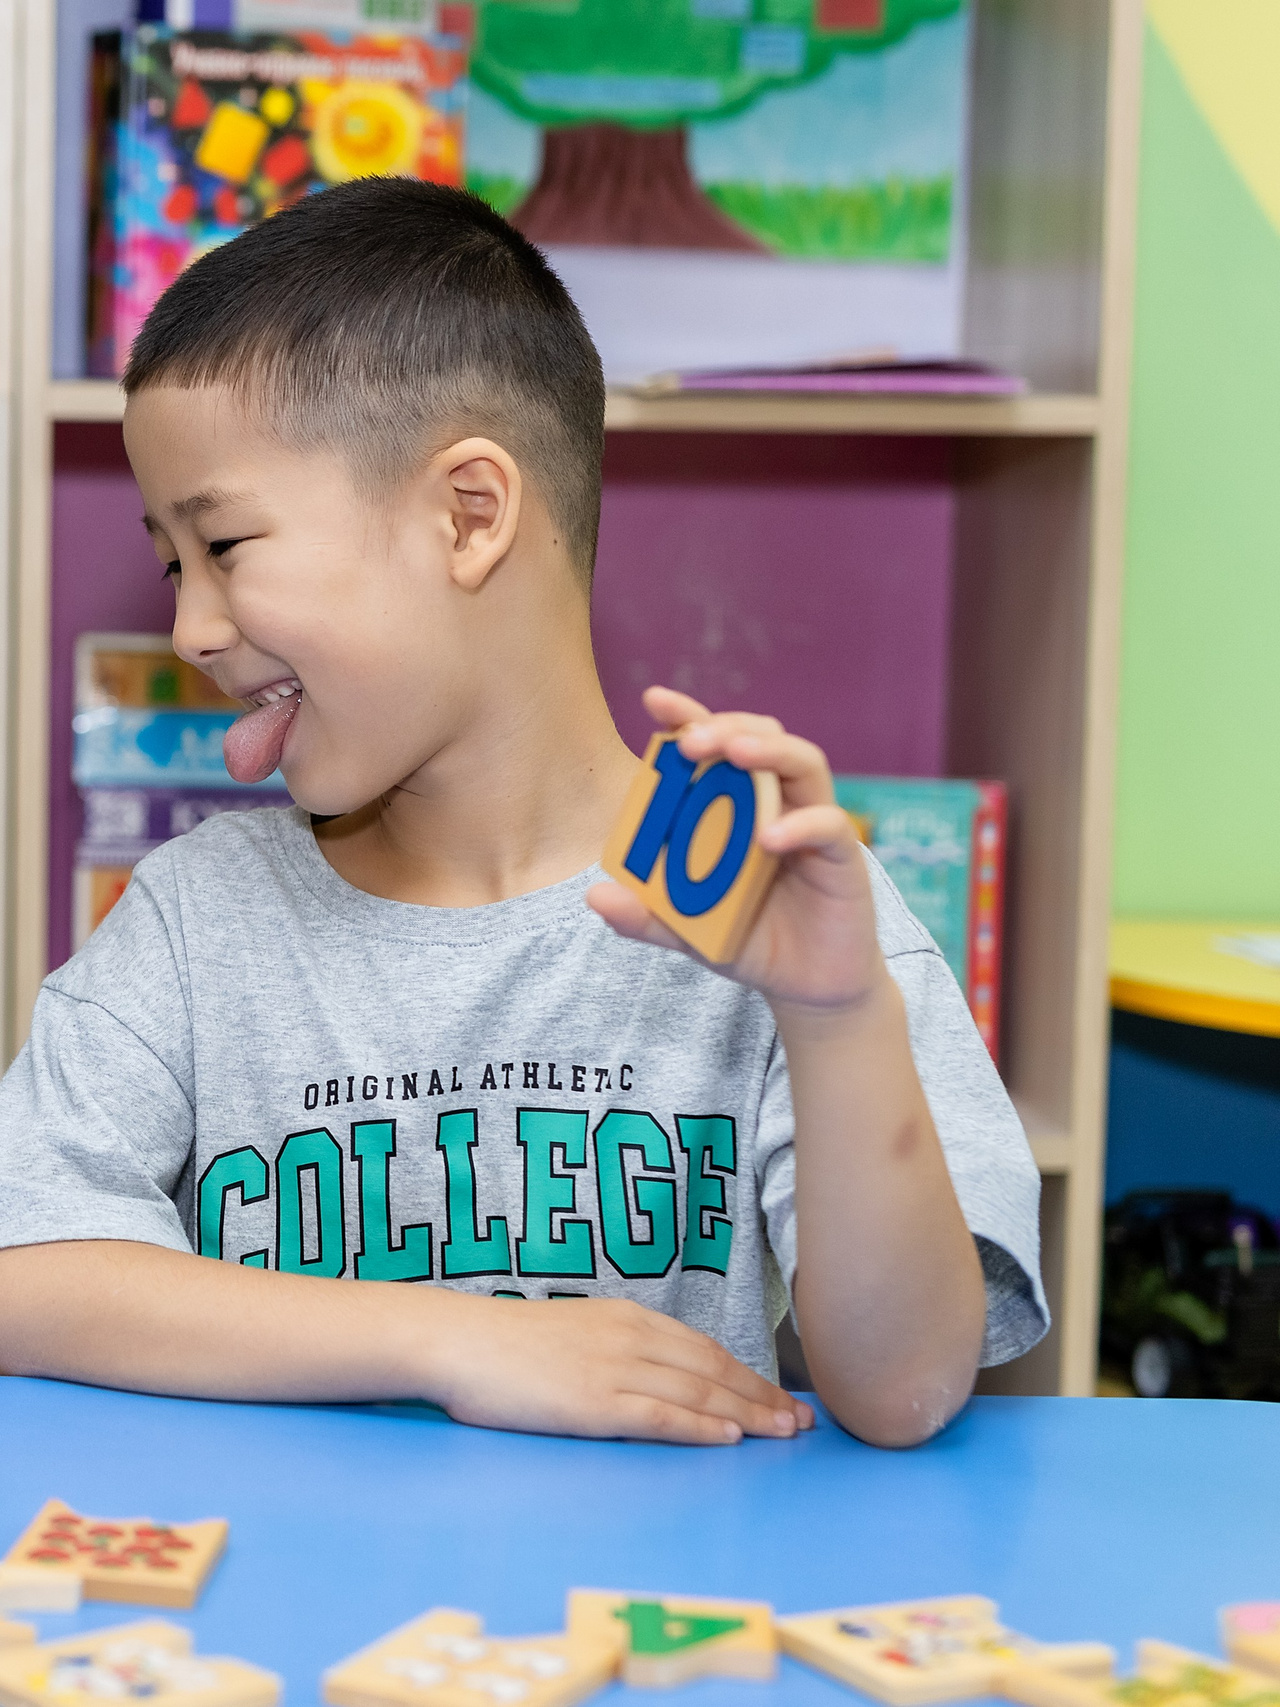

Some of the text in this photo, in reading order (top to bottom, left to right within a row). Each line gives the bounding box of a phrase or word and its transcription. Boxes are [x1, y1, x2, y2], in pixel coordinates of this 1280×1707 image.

[624, 740, 756, 917] 10
[304, 1066, 462, 1111] ORIGINAL
[197, 1107, 737, 1281] COLLEGE
